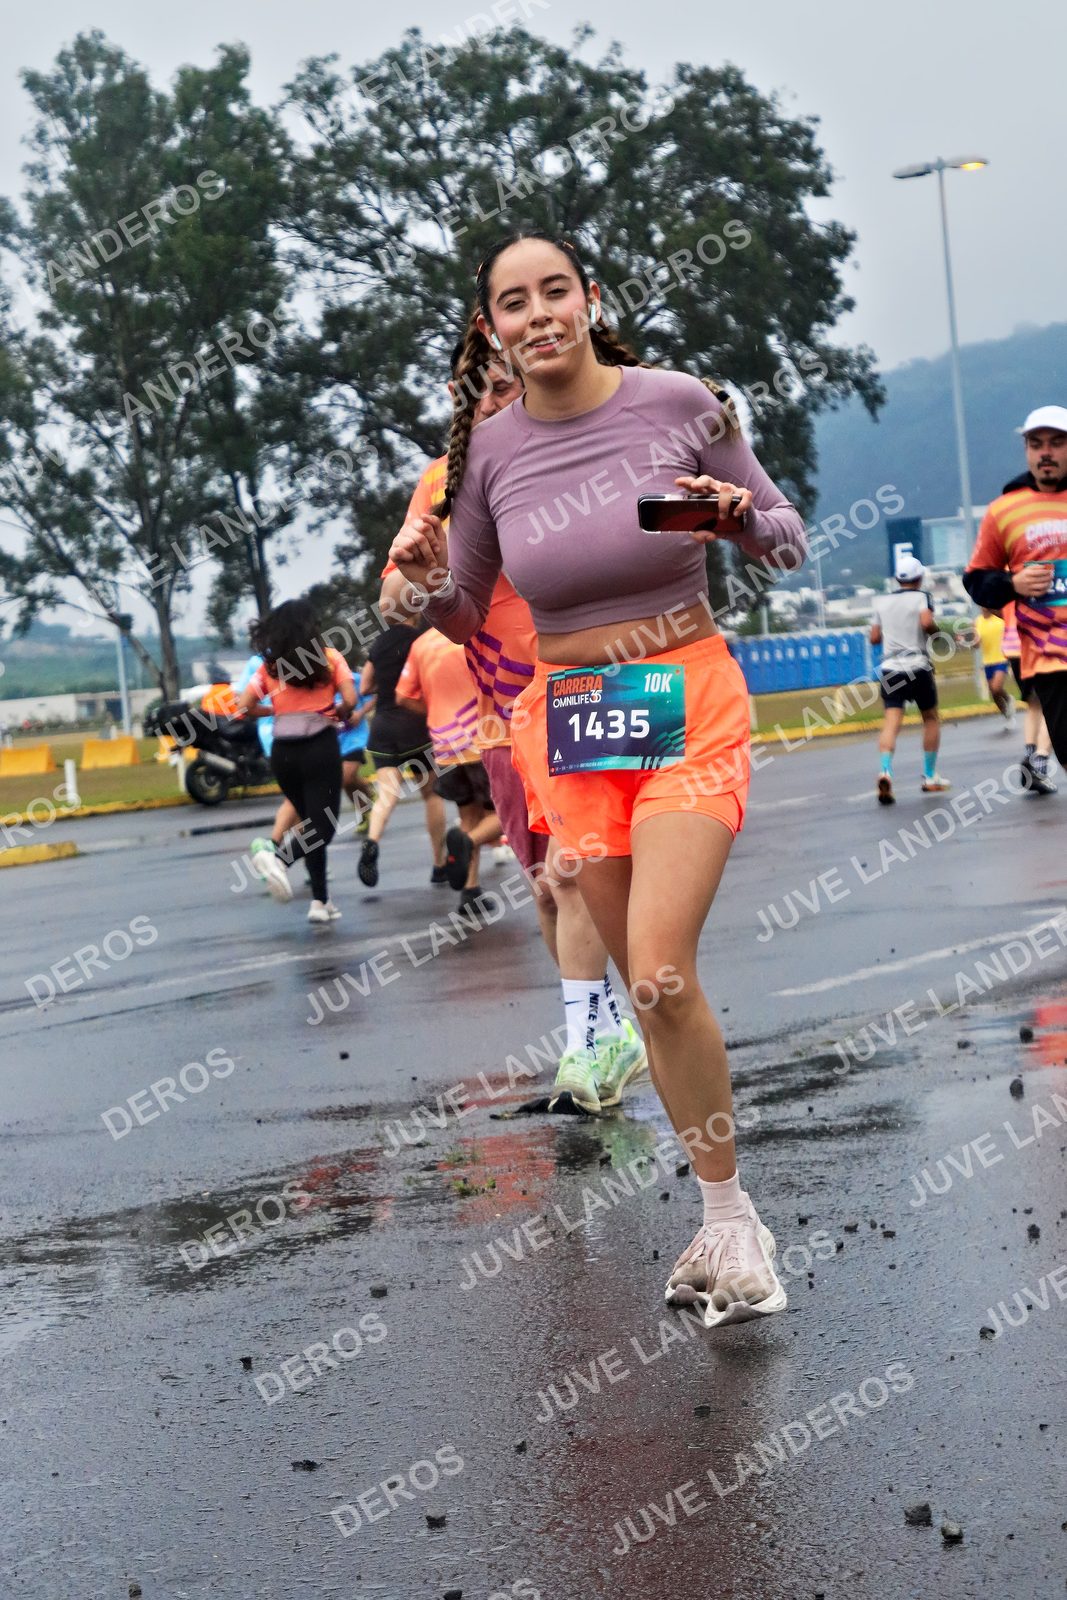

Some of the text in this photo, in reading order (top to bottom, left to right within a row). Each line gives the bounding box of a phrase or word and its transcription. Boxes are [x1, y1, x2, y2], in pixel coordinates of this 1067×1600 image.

[553, 675, 603, 697] CARRERA
[644, 672, 673, 693] 10K
[568, 709, 650, 742] 1435
[588, 992, 600, 1021] NIKE
